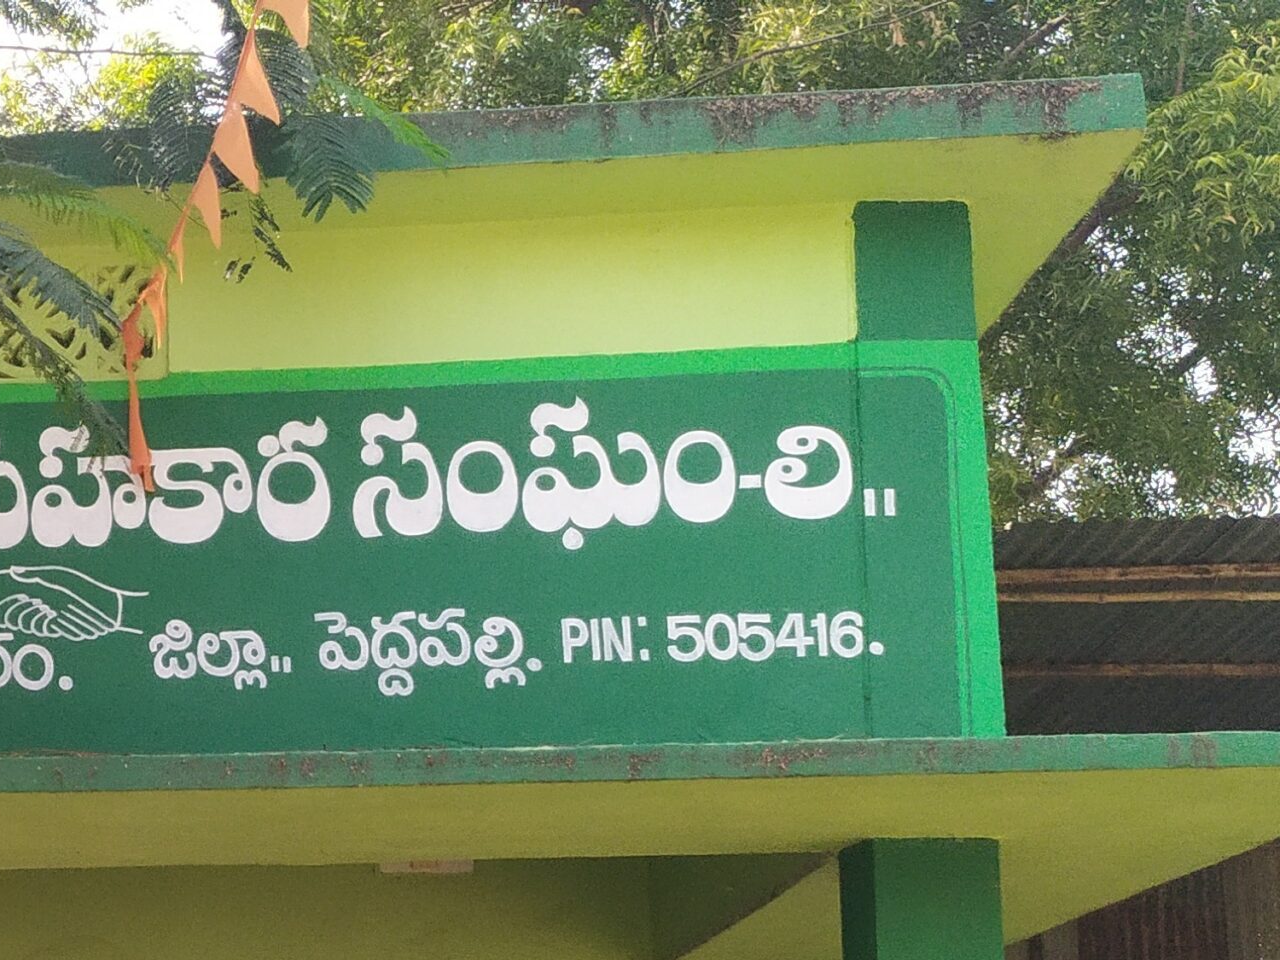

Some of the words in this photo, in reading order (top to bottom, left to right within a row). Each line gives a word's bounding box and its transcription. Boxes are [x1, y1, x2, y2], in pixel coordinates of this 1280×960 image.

[313, 607, 543, 697] పెద్దపల్లి.
[560, 615, 650, 664] PIN:
[666, 610, 885, 663] 505416.
